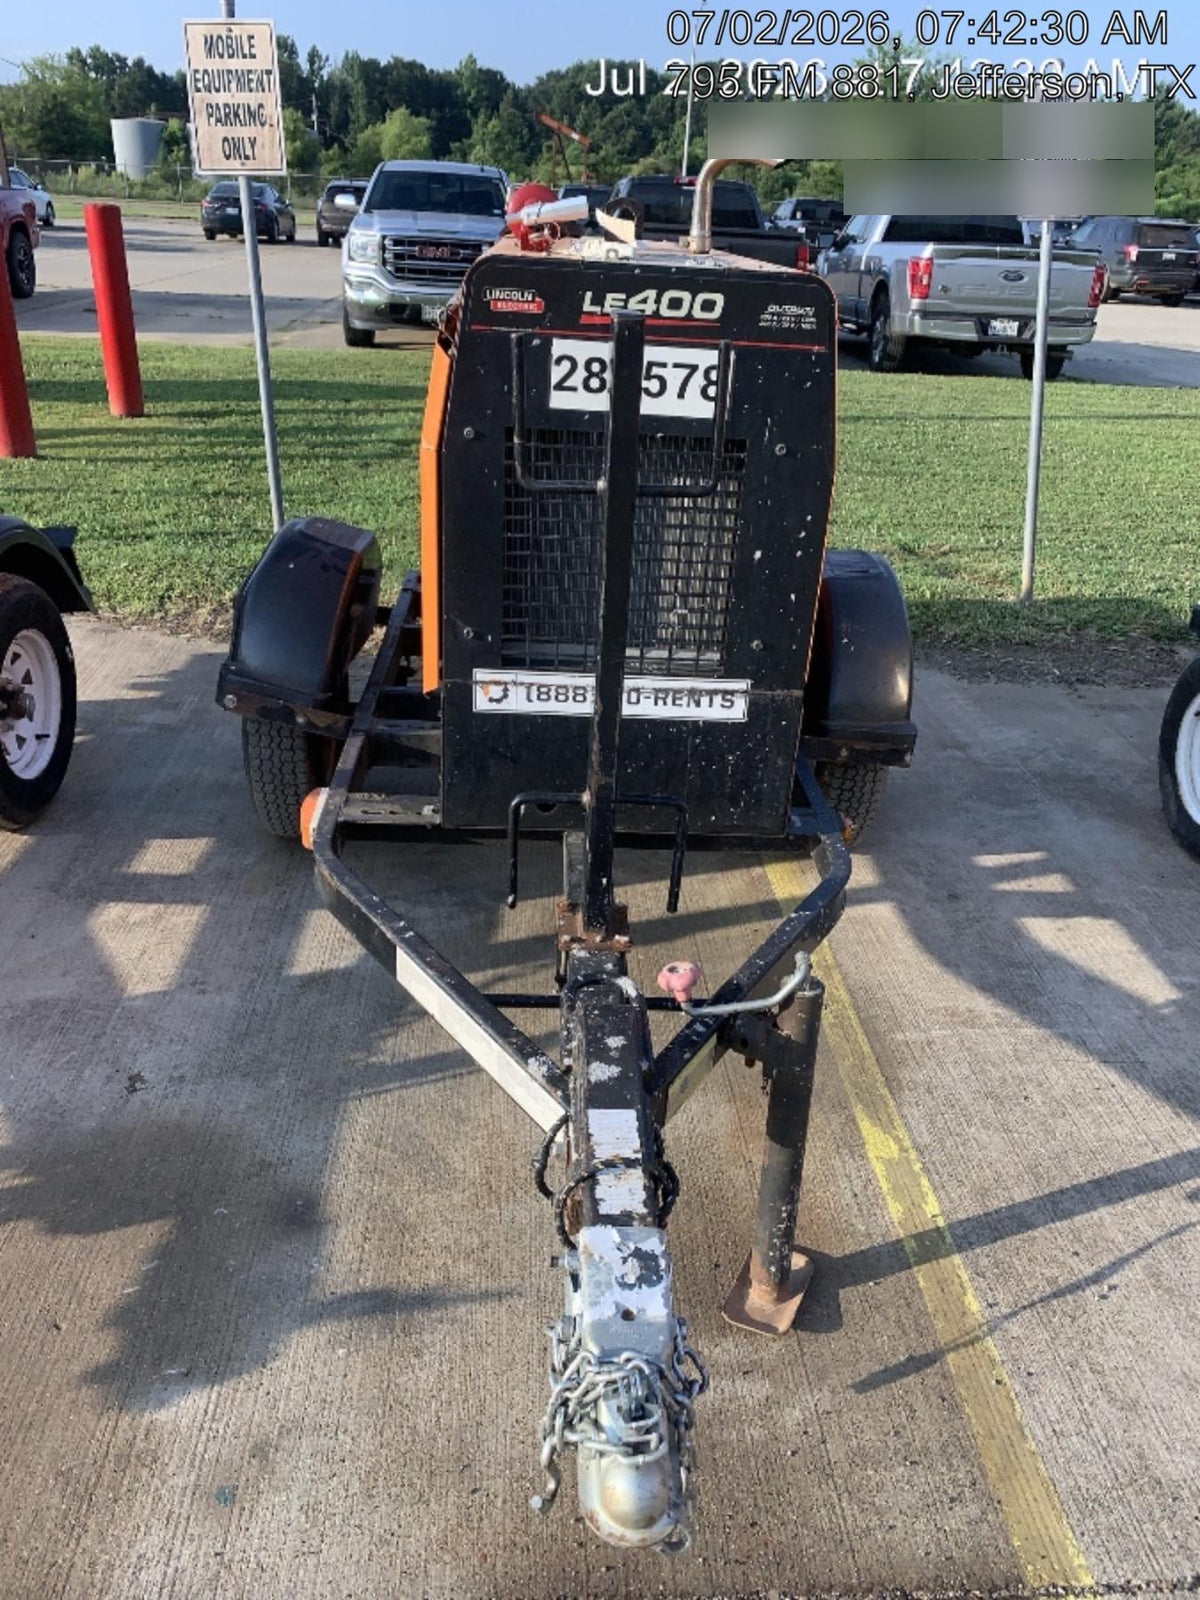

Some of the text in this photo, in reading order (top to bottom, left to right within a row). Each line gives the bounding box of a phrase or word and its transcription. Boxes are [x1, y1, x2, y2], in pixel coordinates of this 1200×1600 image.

[204, 34, 256, 60] MOBILE
[193, 69, 273, 93] EQUIPMENT
[205, 103, 268, 127] PARKING
[222, 136, 257, 161] ONLY
[486, 289, 533, 301] LINCOLN
[582, 288, 725, 319] LE400
[552, 354, 717, 402] 28578
